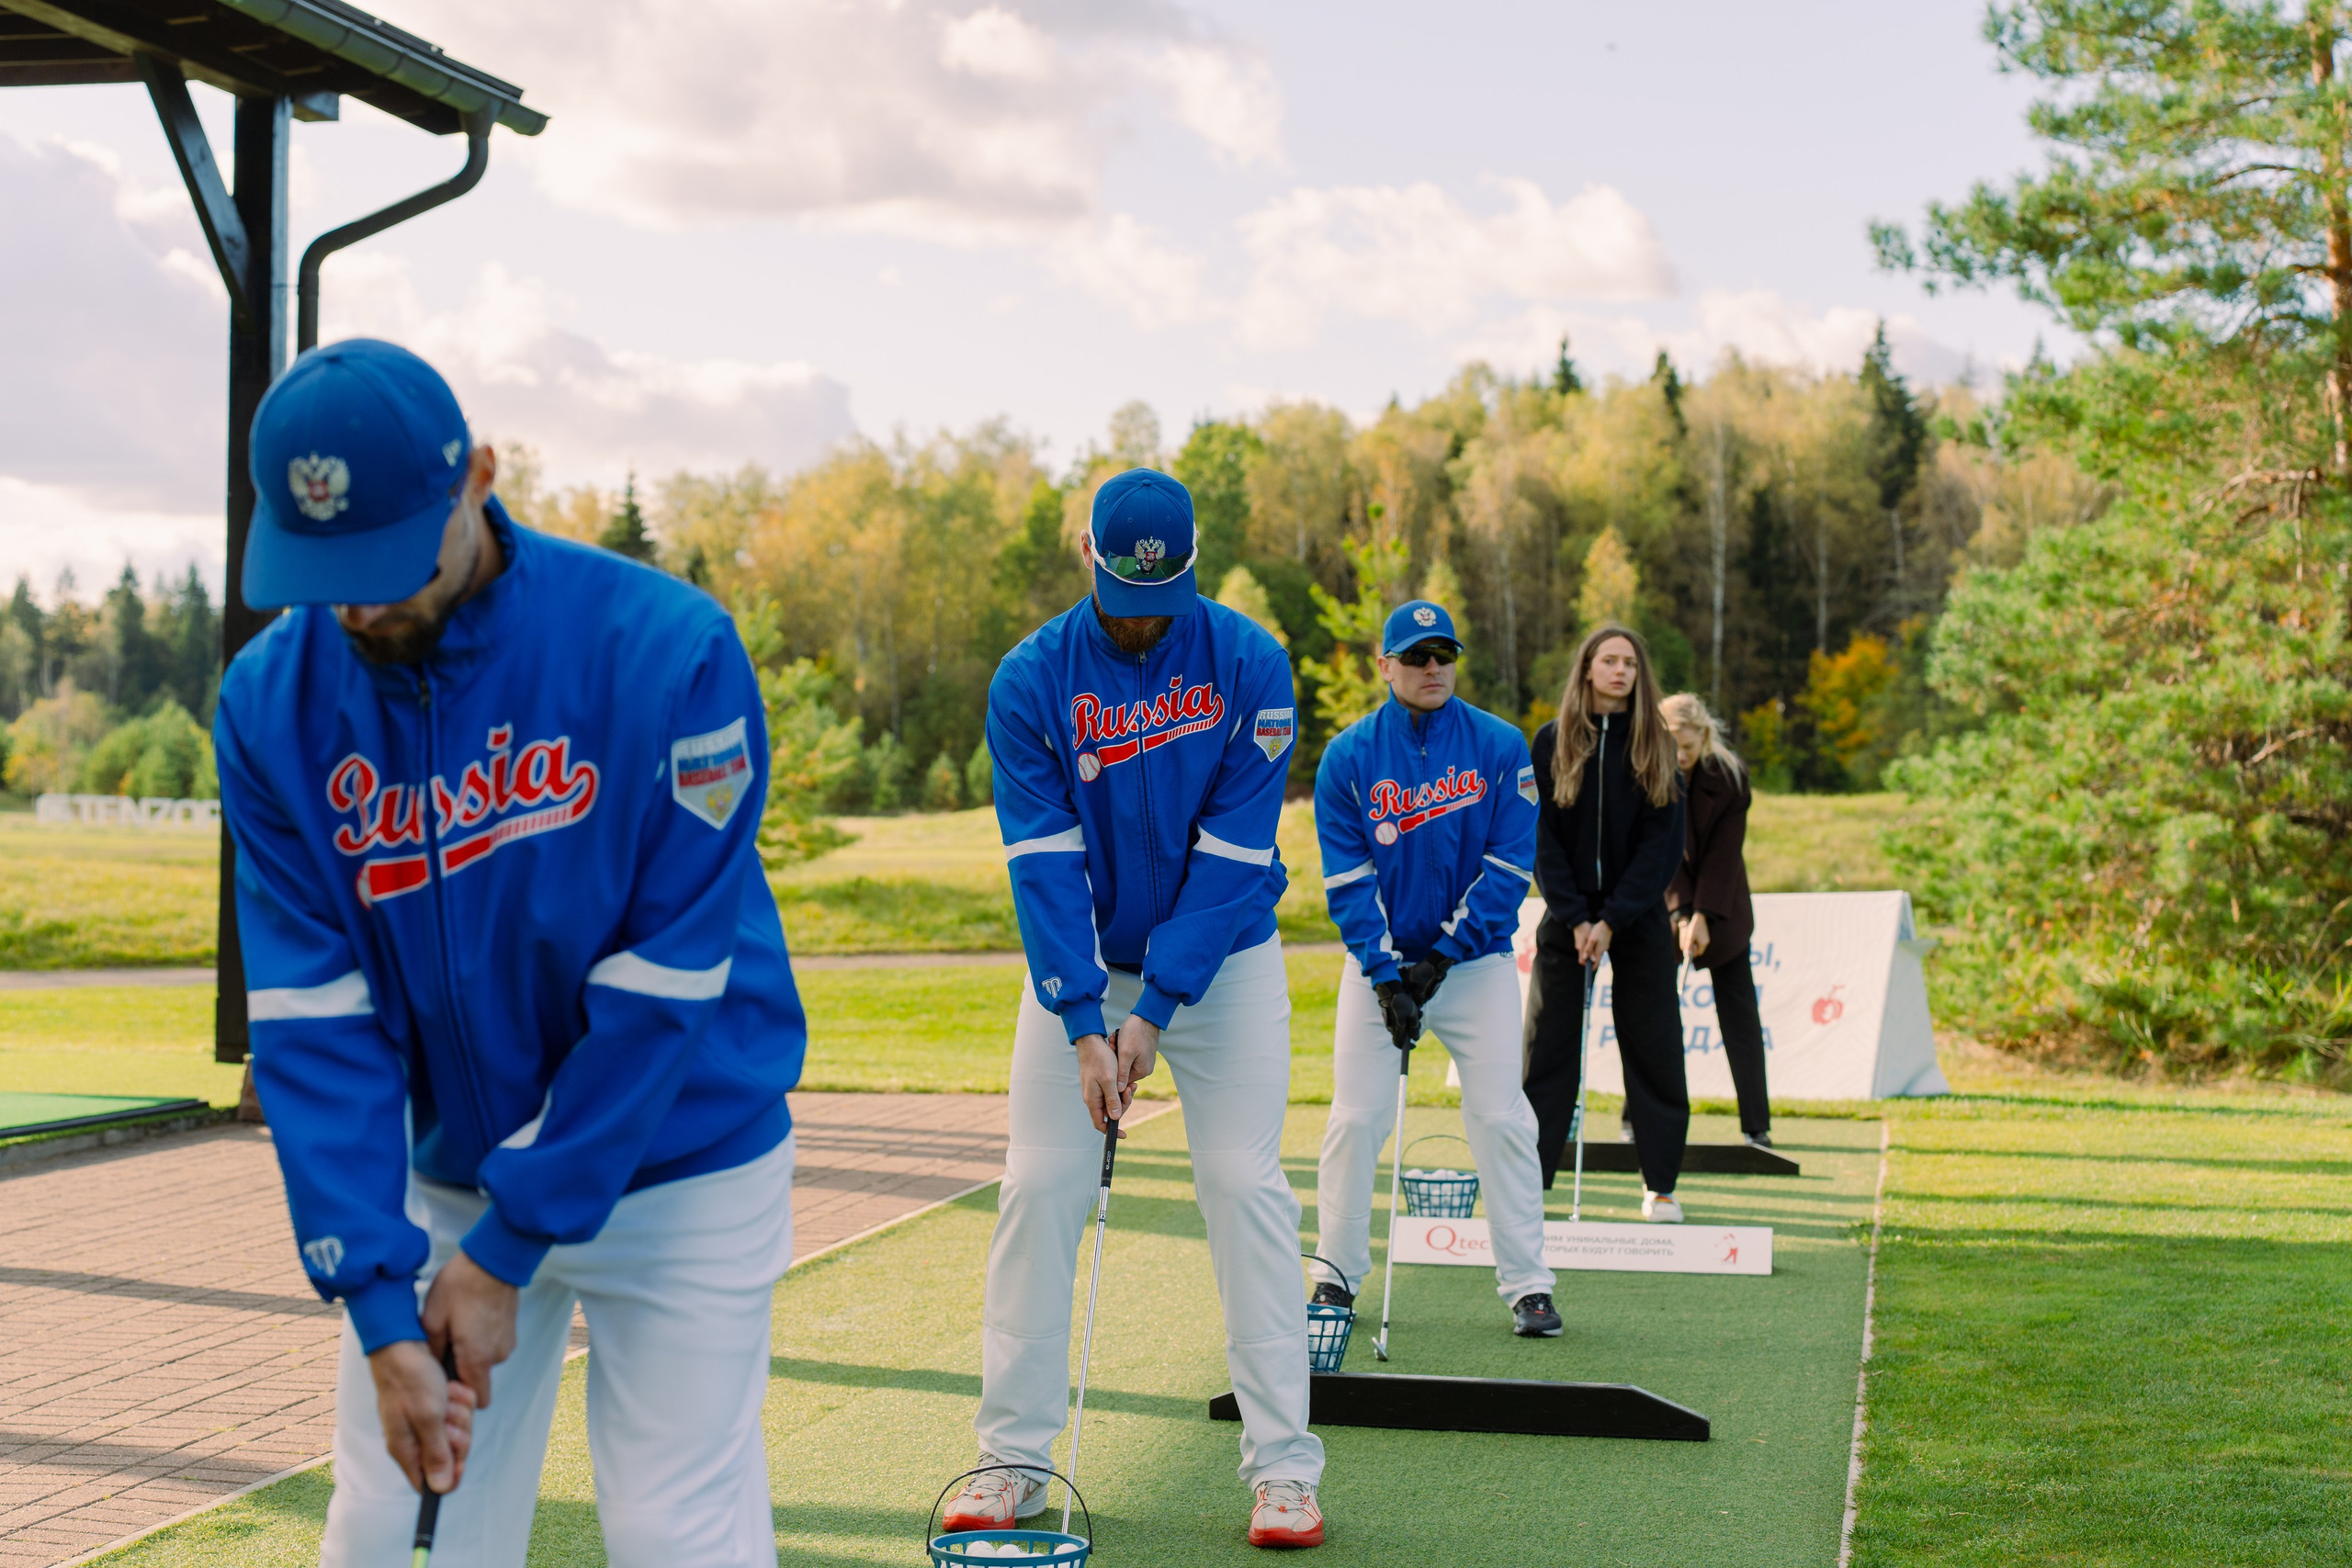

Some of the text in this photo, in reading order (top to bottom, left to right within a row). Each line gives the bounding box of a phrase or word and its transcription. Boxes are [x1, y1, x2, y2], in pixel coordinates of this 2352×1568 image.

[1070, 674, 1225, 750] Russia
[1369, 765, 1487, 820] Russia
[1426, 1224, 1489, 1257] Qtec
[1566, 1235, 1636, 1246] УНИКАЛЬНЫЕ
[1582, 1247, 1615, 1255] БУДУТ
[1618, 1247, 1674, 1257] ГОВОРИТЬ
